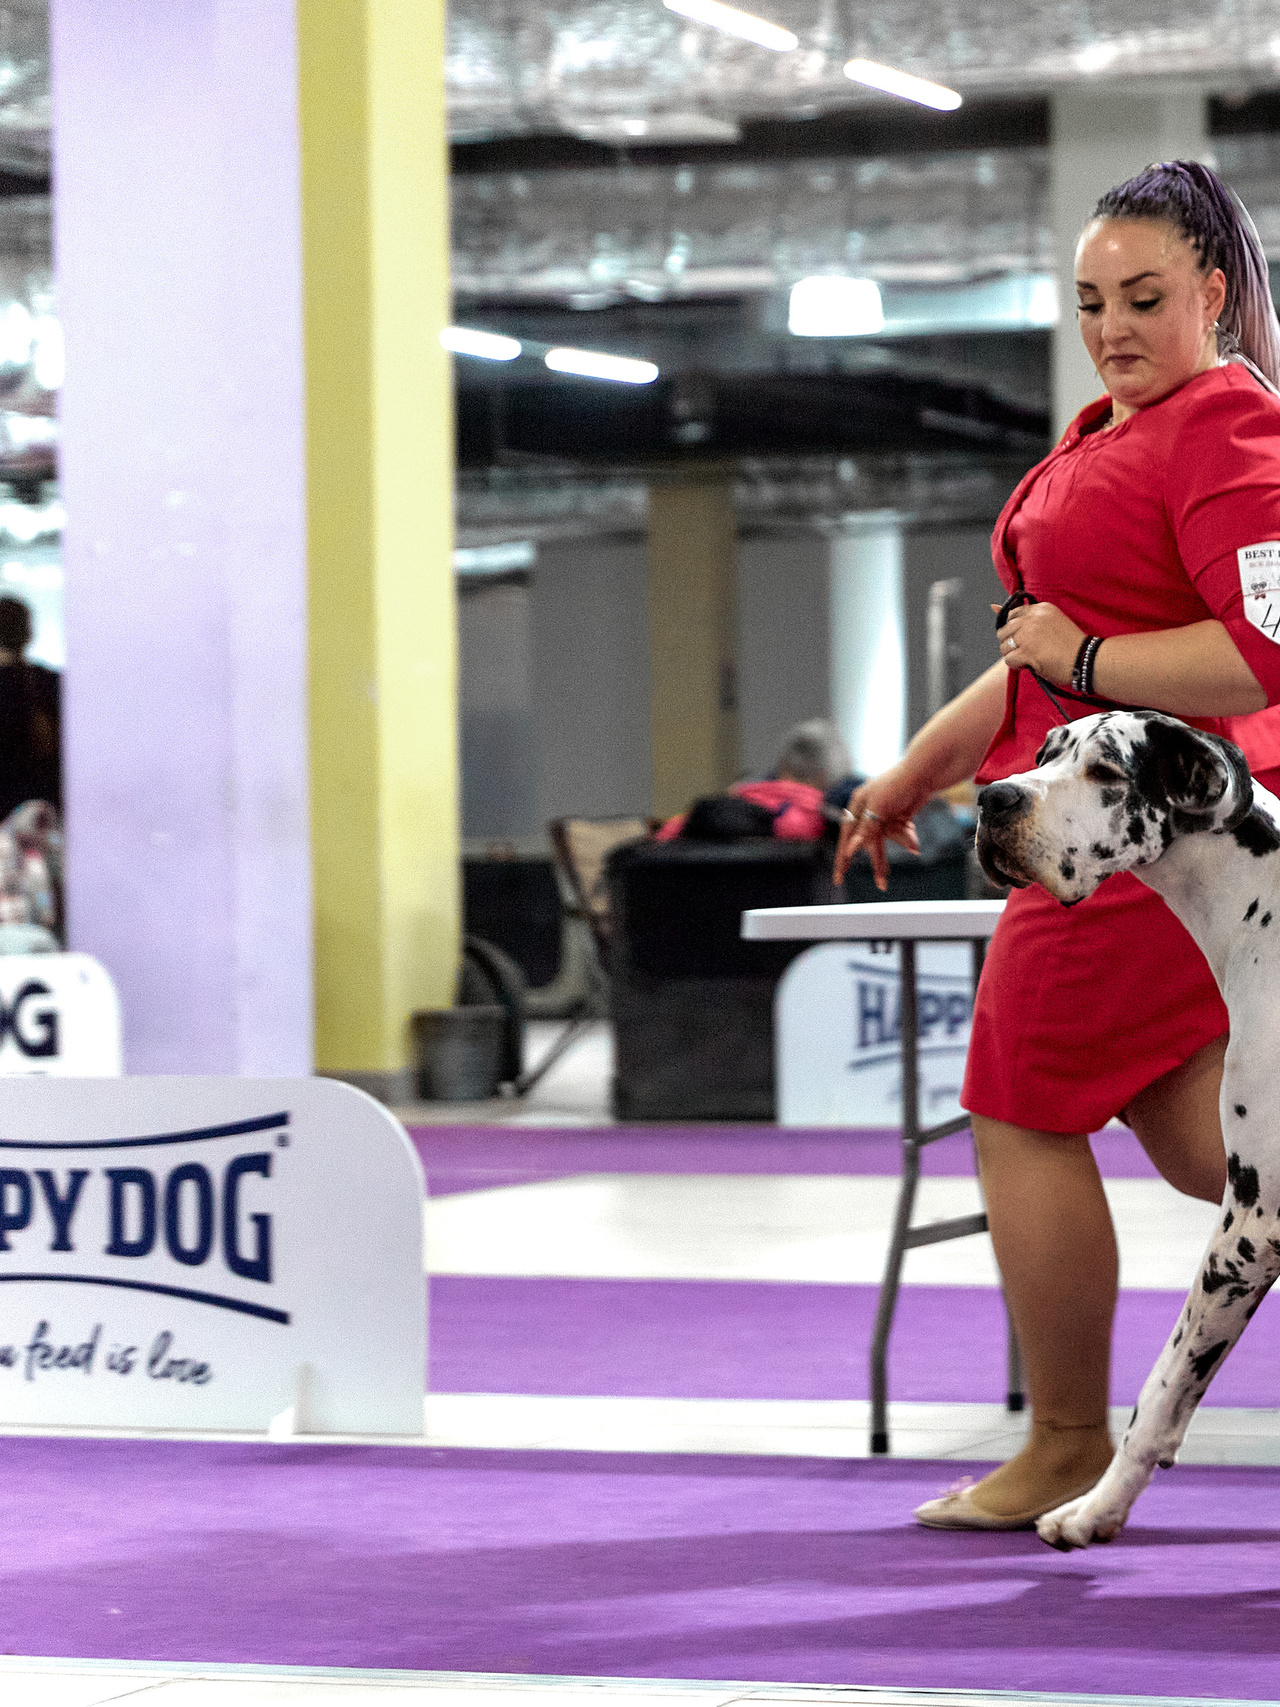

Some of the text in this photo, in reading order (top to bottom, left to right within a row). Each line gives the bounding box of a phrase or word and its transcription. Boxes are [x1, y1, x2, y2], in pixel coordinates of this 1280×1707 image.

[1244, 549, 1275, 560] BEST
[103, 1152, 272, 1284] DOG
[25, 1320, 212, 1385] feed is love
